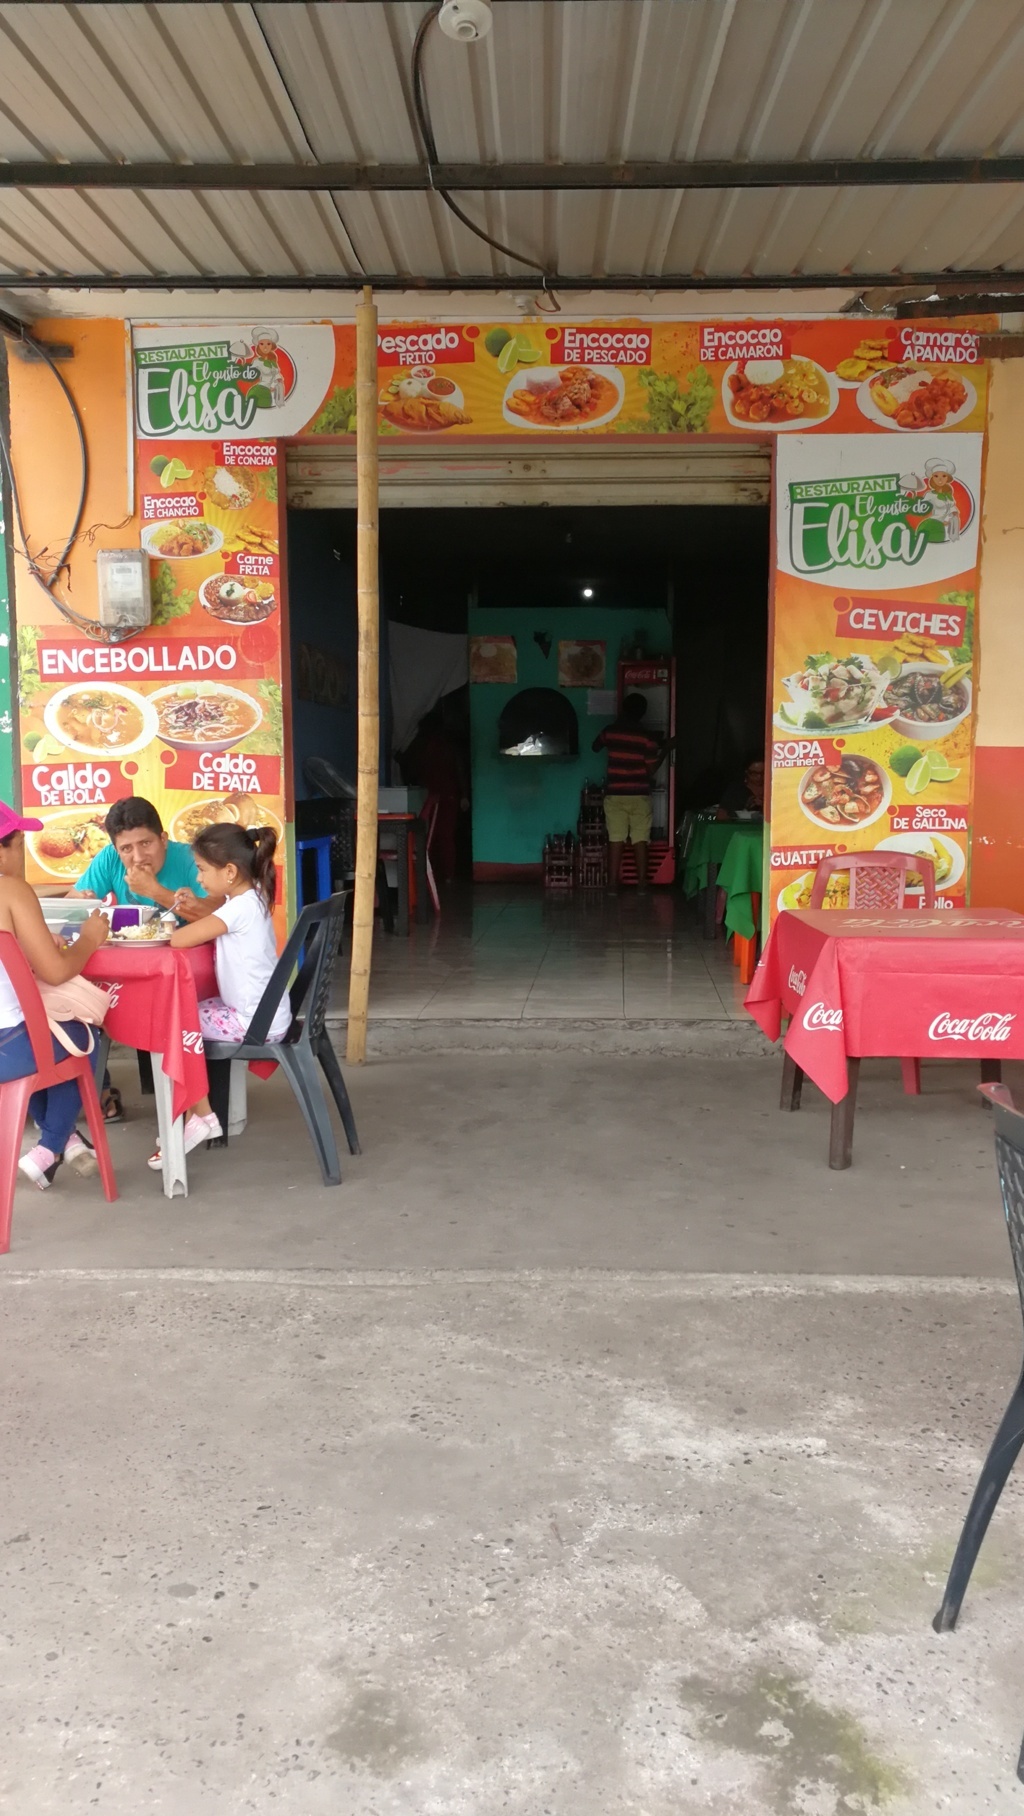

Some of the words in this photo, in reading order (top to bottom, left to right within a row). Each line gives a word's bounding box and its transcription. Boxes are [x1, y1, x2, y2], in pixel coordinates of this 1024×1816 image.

[378, 328, 459, 353] escado
[564, 329, 650, 350] Encocao
[703, 327, 782, 347] Encocao
[138, 345, 228, 364] RESTAURANT
[399, 351, 436, 366] FRITO
[564, 349, 582, 362] DE
[584, 350, 647, 364] PESCADO
[701, 346, 716, 361] DE
[717, 344, 783, 360] CAMARÓN
[902, 345, 978, 364] APANADO
[192, 361, 211, 382] El
[212, 365, 241, 387] gusto
[242, 365, 257, 379] de
[139, 367, 254, 434] Elisa
[223, 442, 277, 456] Encocao
[224, 456, 235, 465] DE
[237, 456, 274, 466] CONCHA
[794, 479, 895, 498] RESTAURANT
[144, 496, 197, 509] Encocao
[144, 508, 155, 518] DE
[156, 506, 199, 517] CHANCHO
[855, 495, 875, 517] El
[877, 498, 911, 523] gusto
[912, 499, 930, 514] de
[792, 502, 926, 571] Elisa
[236, 553, 274, 565] Carne
[239, 564, 270, 576] FRITA
[849, 608, 961, 637] CEVICHES
[42, 644, 236, 675] ENCEBOLLADO
[773, 740, 824, 759] SOPA
[198, 752, 257, 775] Caldo
[773, 756, 825, 767] marinera
[32, 763, 111, 791] Caldo
[192, 773, 214, 790] DE
[218, 774, 262, 792] PATA
[41, 790, 61, 806] DE
[63, 788, 106, 805] BOLA
[915, 806, 947, 818] Seco
[893, 818, 910, 829] DE
[912, 818, 968, 830] GALLINA
[919, 896, 954, 910] Pllo
[928, 1012, 1017, 1042] Coca-Cola
